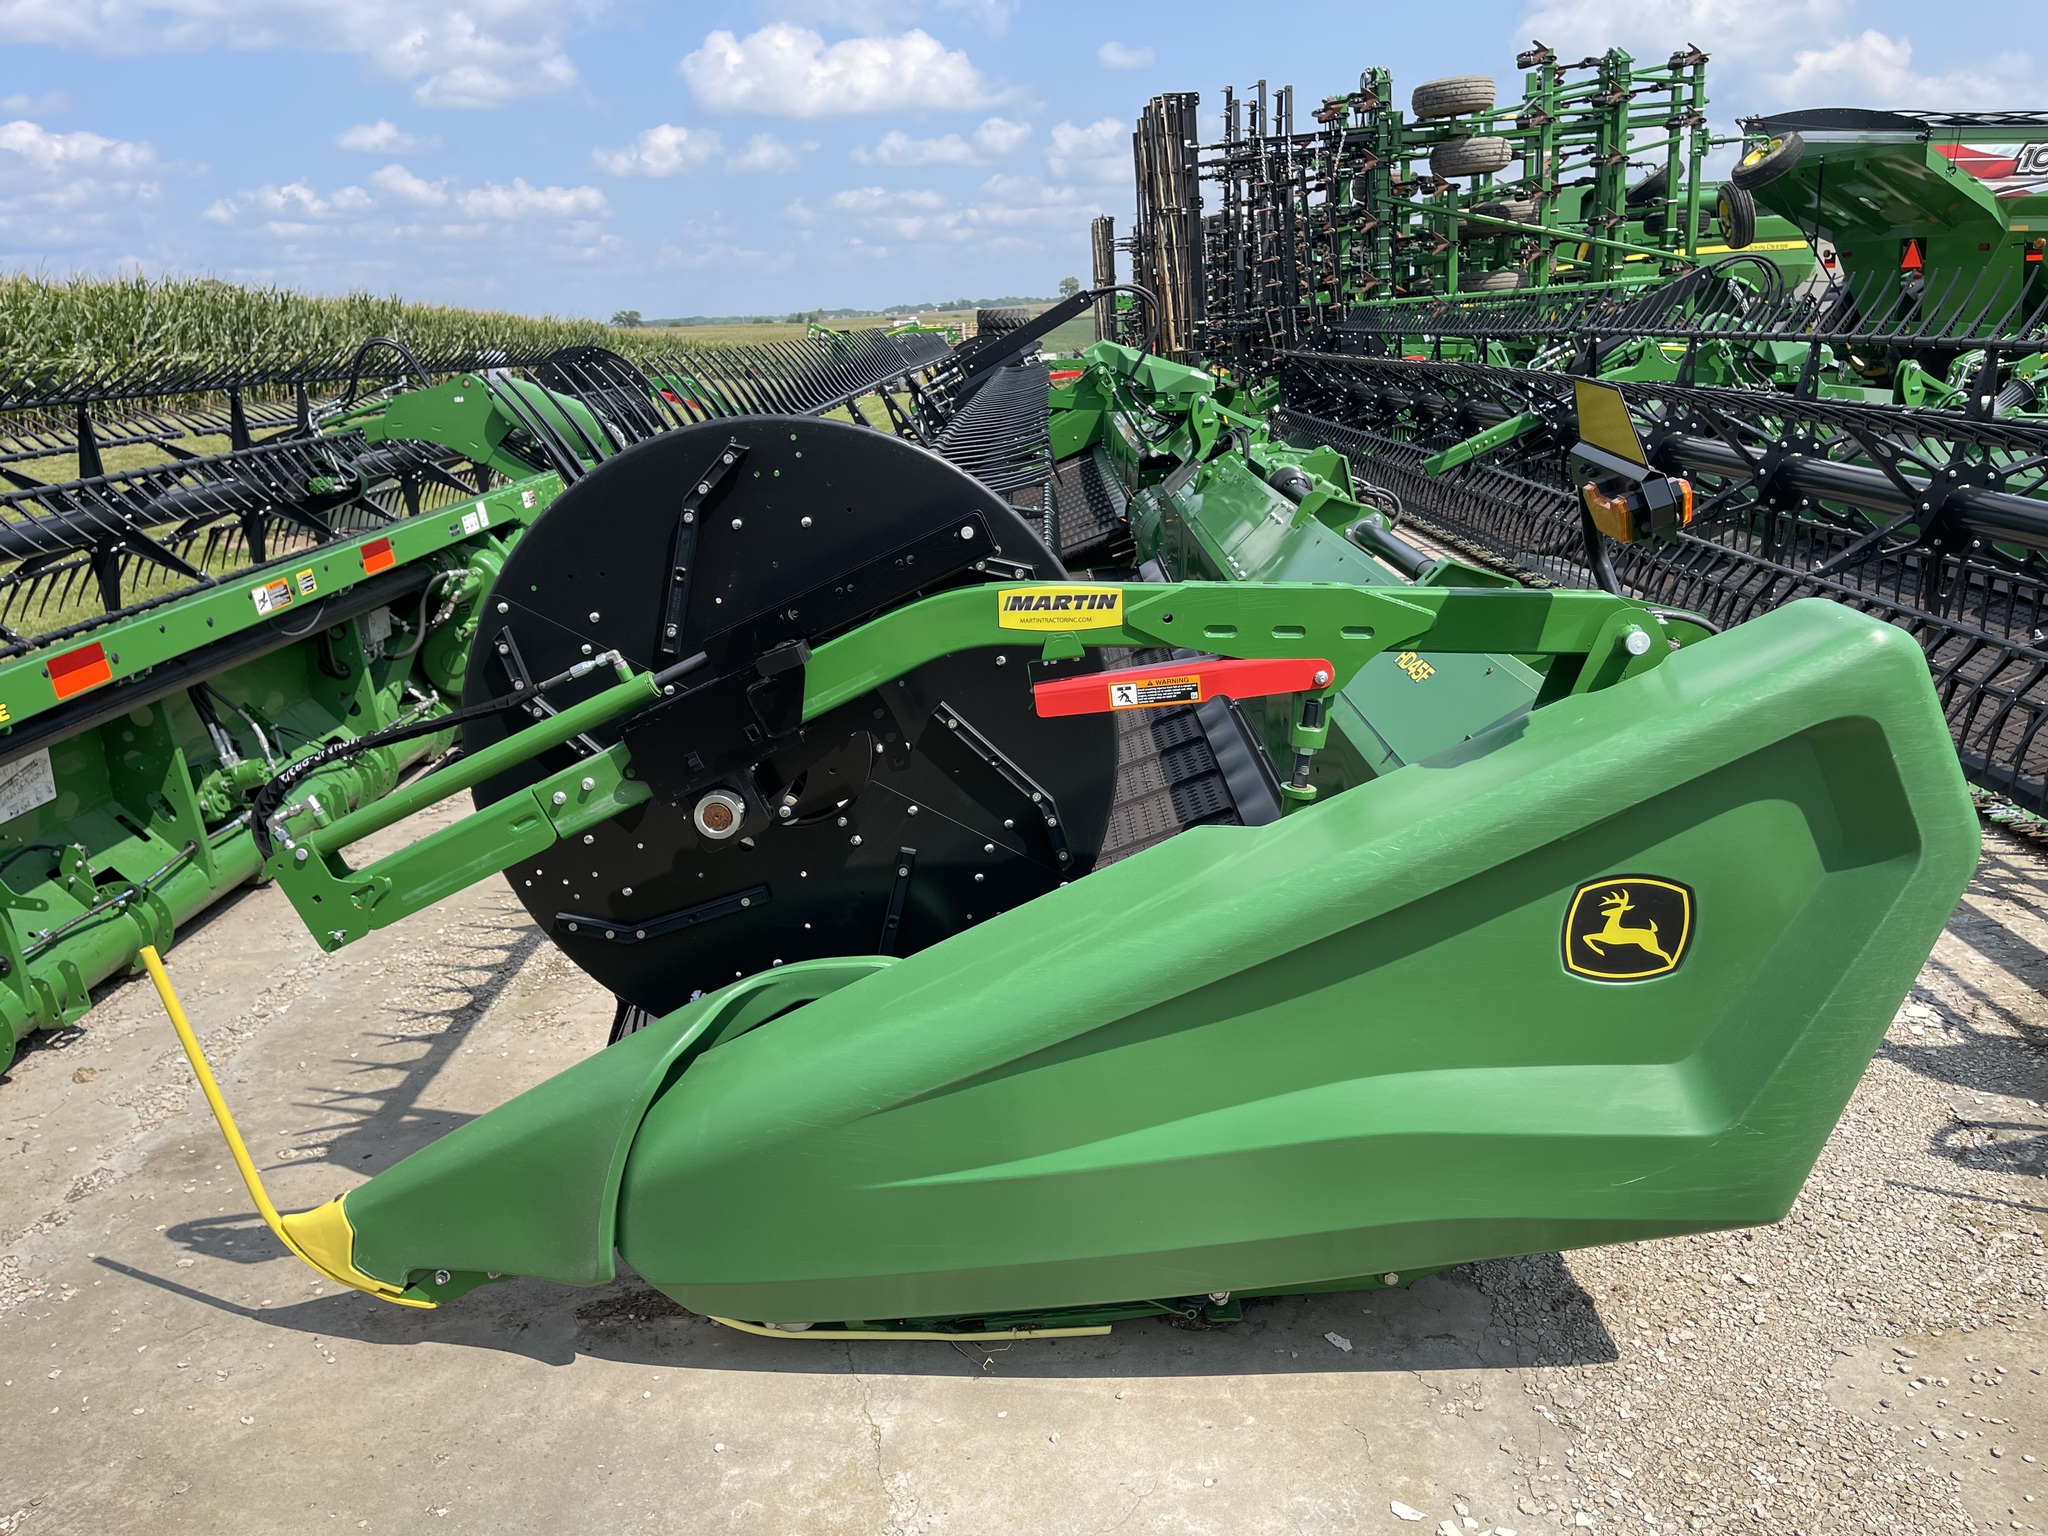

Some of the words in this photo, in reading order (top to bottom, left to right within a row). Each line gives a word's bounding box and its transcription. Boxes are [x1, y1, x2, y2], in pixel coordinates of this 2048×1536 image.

[1008, 594, 1118, 611] MARTIN
[1393, 651, 1437, 684] HD45F
[1155, 677, 1190, 686] WARNING
